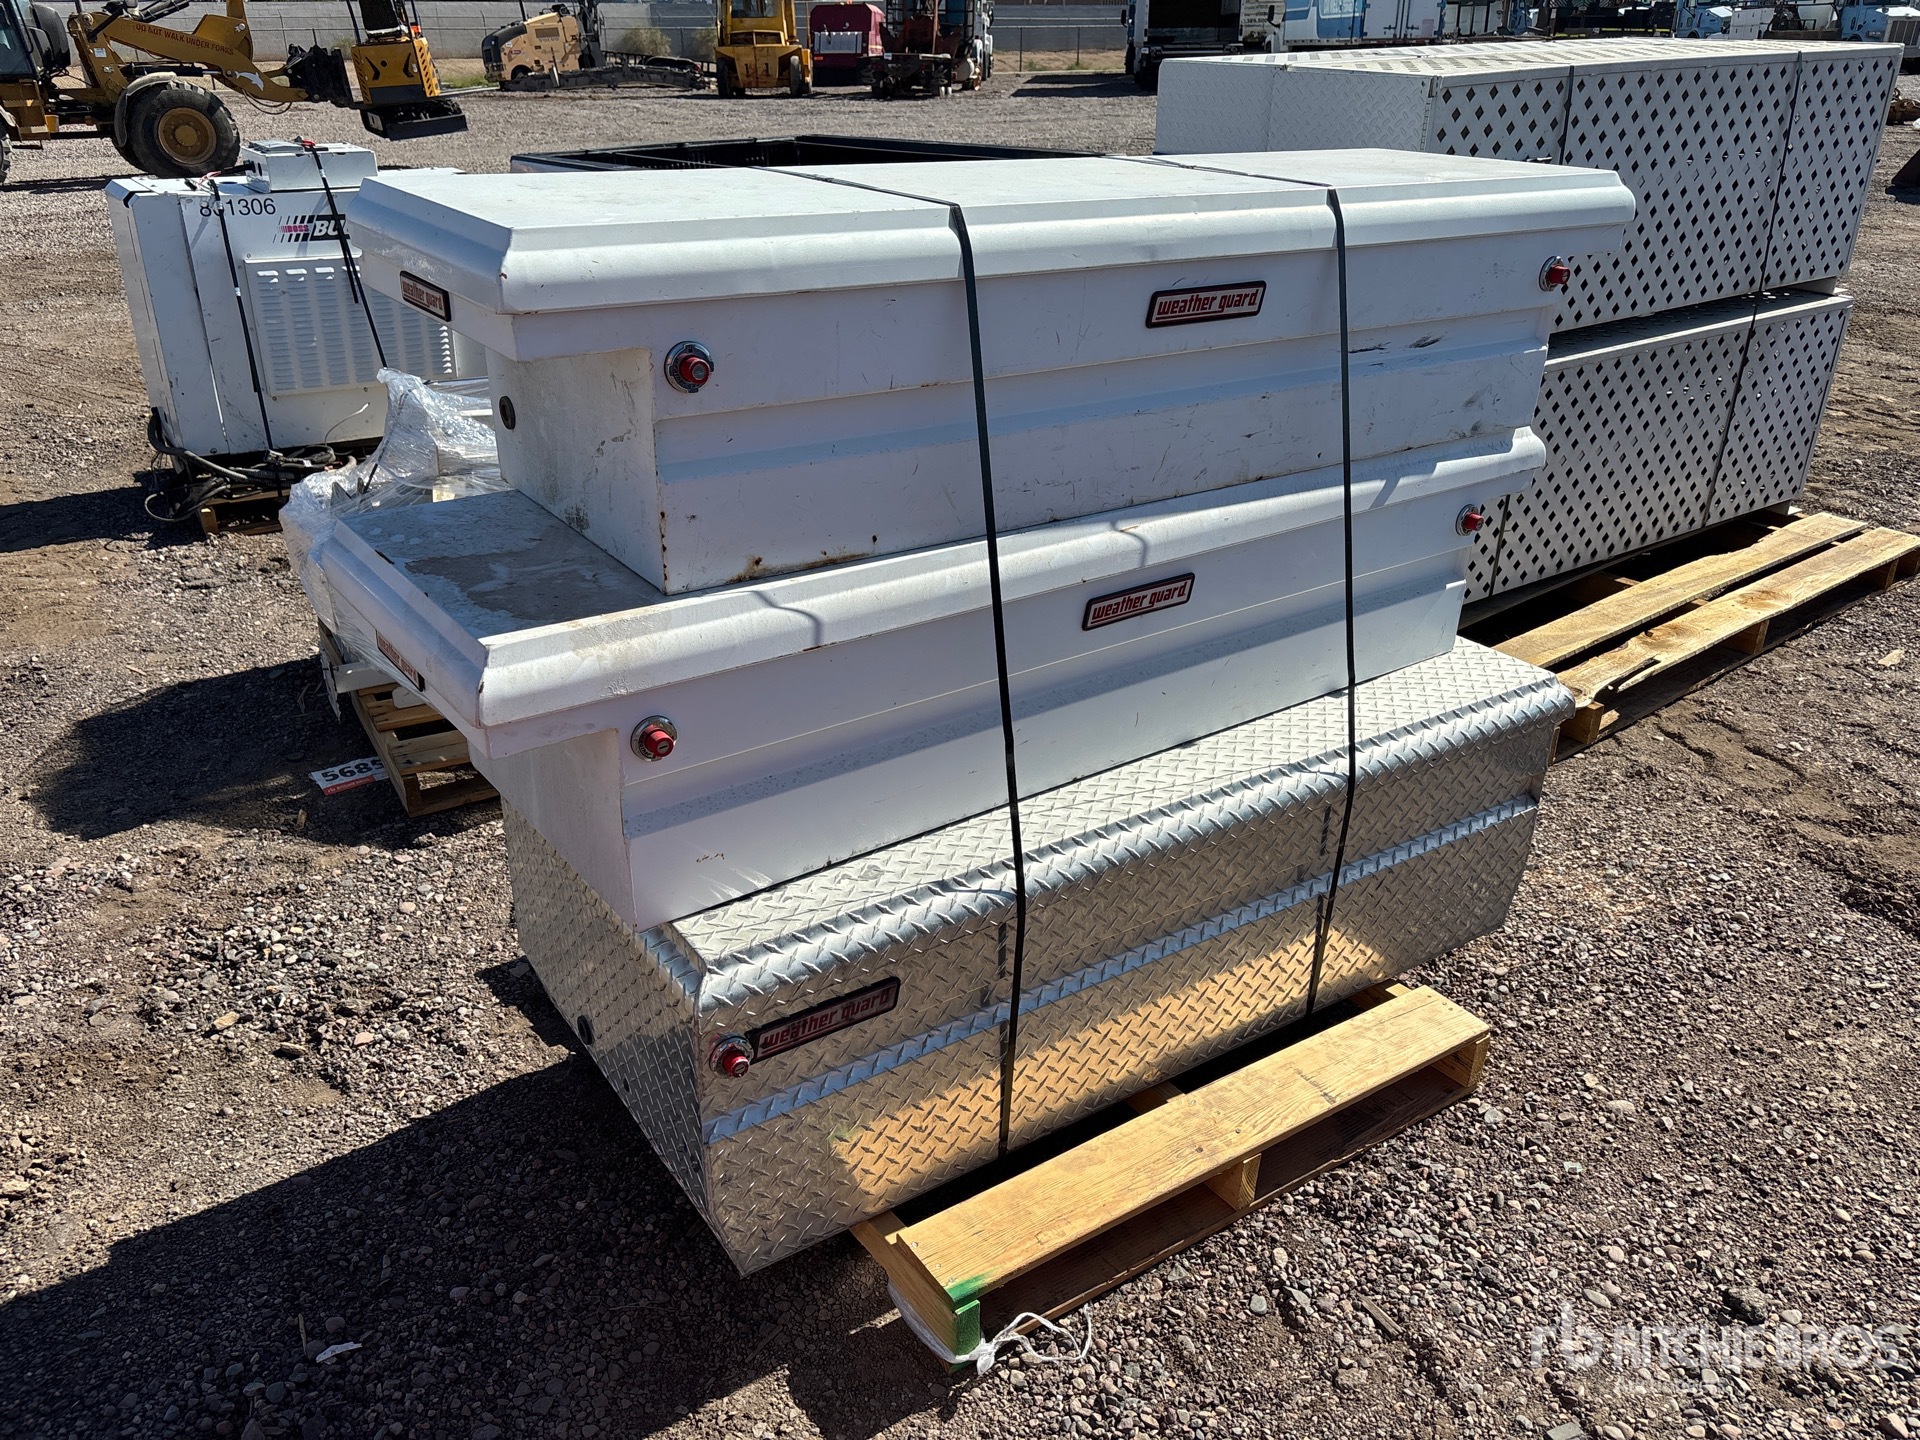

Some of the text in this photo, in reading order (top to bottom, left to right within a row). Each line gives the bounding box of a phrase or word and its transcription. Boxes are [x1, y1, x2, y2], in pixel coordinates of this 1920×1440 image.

[164, 30, 185, 42] WALK
[186, 38, 210, 49] UNDER
[199, 197, 276, 217] 81306
[1157, 288, 1259, 315] weather guard
[1092, 582, 1186, 620] weather guard
[761, 986, 892, 1049] weather guard
